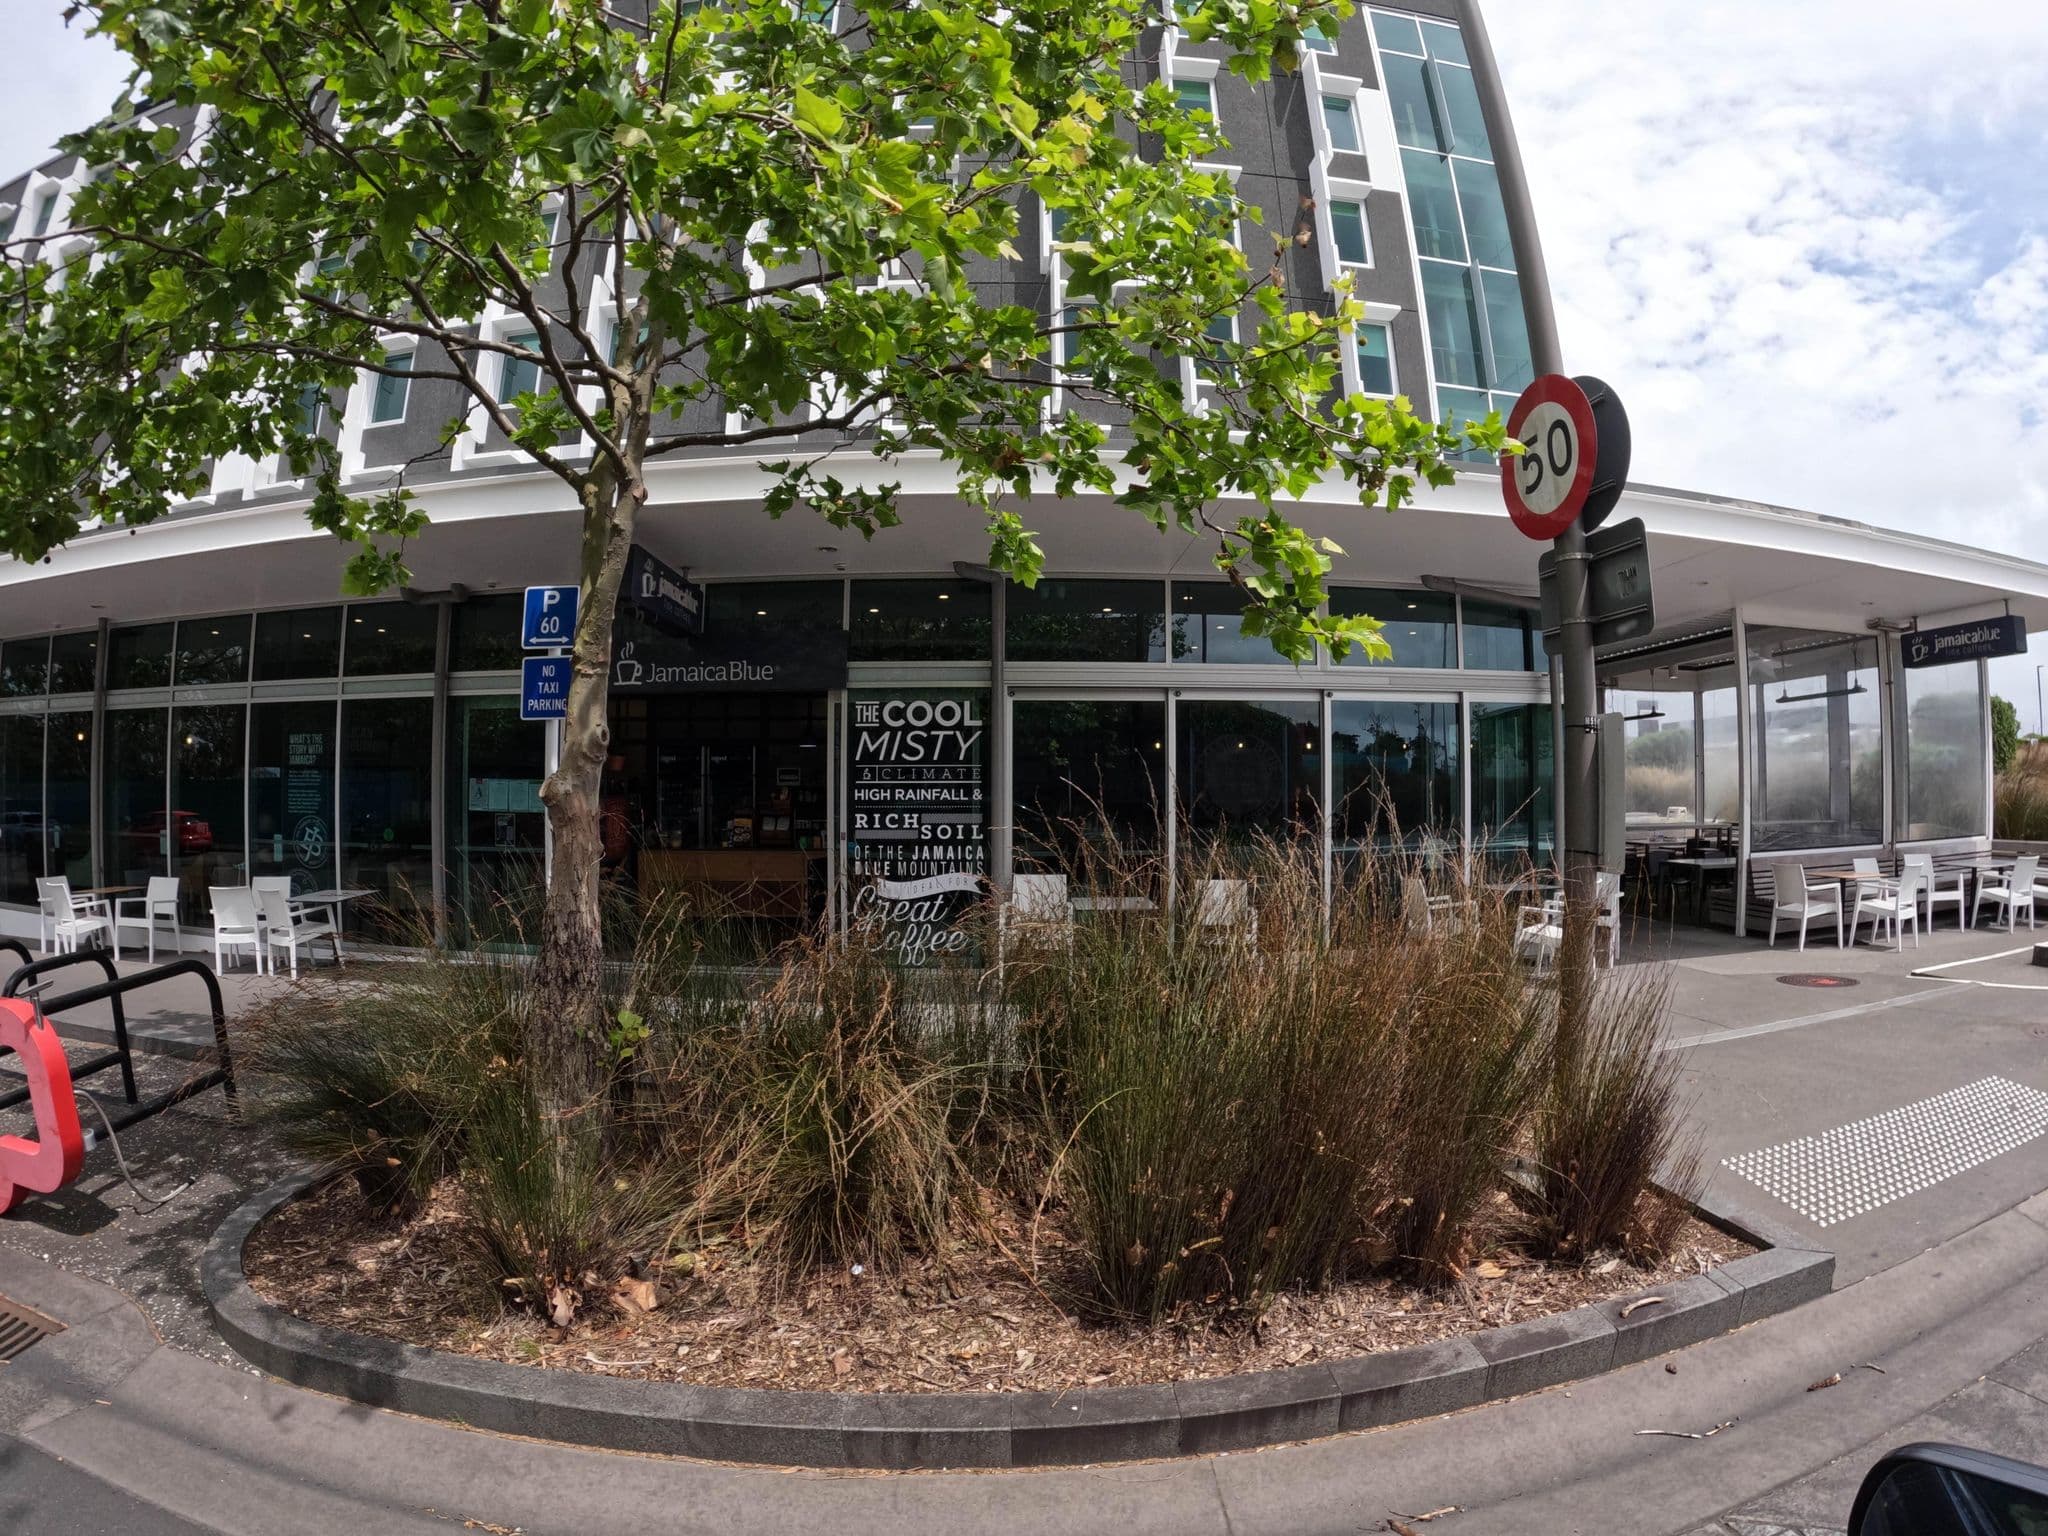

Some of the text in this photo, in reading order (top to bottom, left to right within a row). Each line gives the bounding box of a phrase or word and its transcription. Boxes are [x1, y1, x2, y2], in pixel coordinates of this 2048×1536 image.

[1521, 419, 1572, 495] 50
[543, 590, 561, 613] P
[540, 616, 560, 634] 60
[1933, 625, 2001, 654] jamaicablue
[542, 665, 555, 677] NO
[537, 682, 559, 694] TAXI
[528, 698, 567, 711] PARKING
[855, 700, 983, 727] THE COOL
[855, 730, 983, 761] MISTY
[881, 768, 981, 779] CLIMATE
[854, 788, 983, 801] HIGH RAINFALL &
[854, 813, 984, 839] RICH SOIL
[854, 845, 985, 860] OF THE JAMAICA
[897, 861, 985, 876] MOUNTAINS
[853, 885, 949, 931] Great
